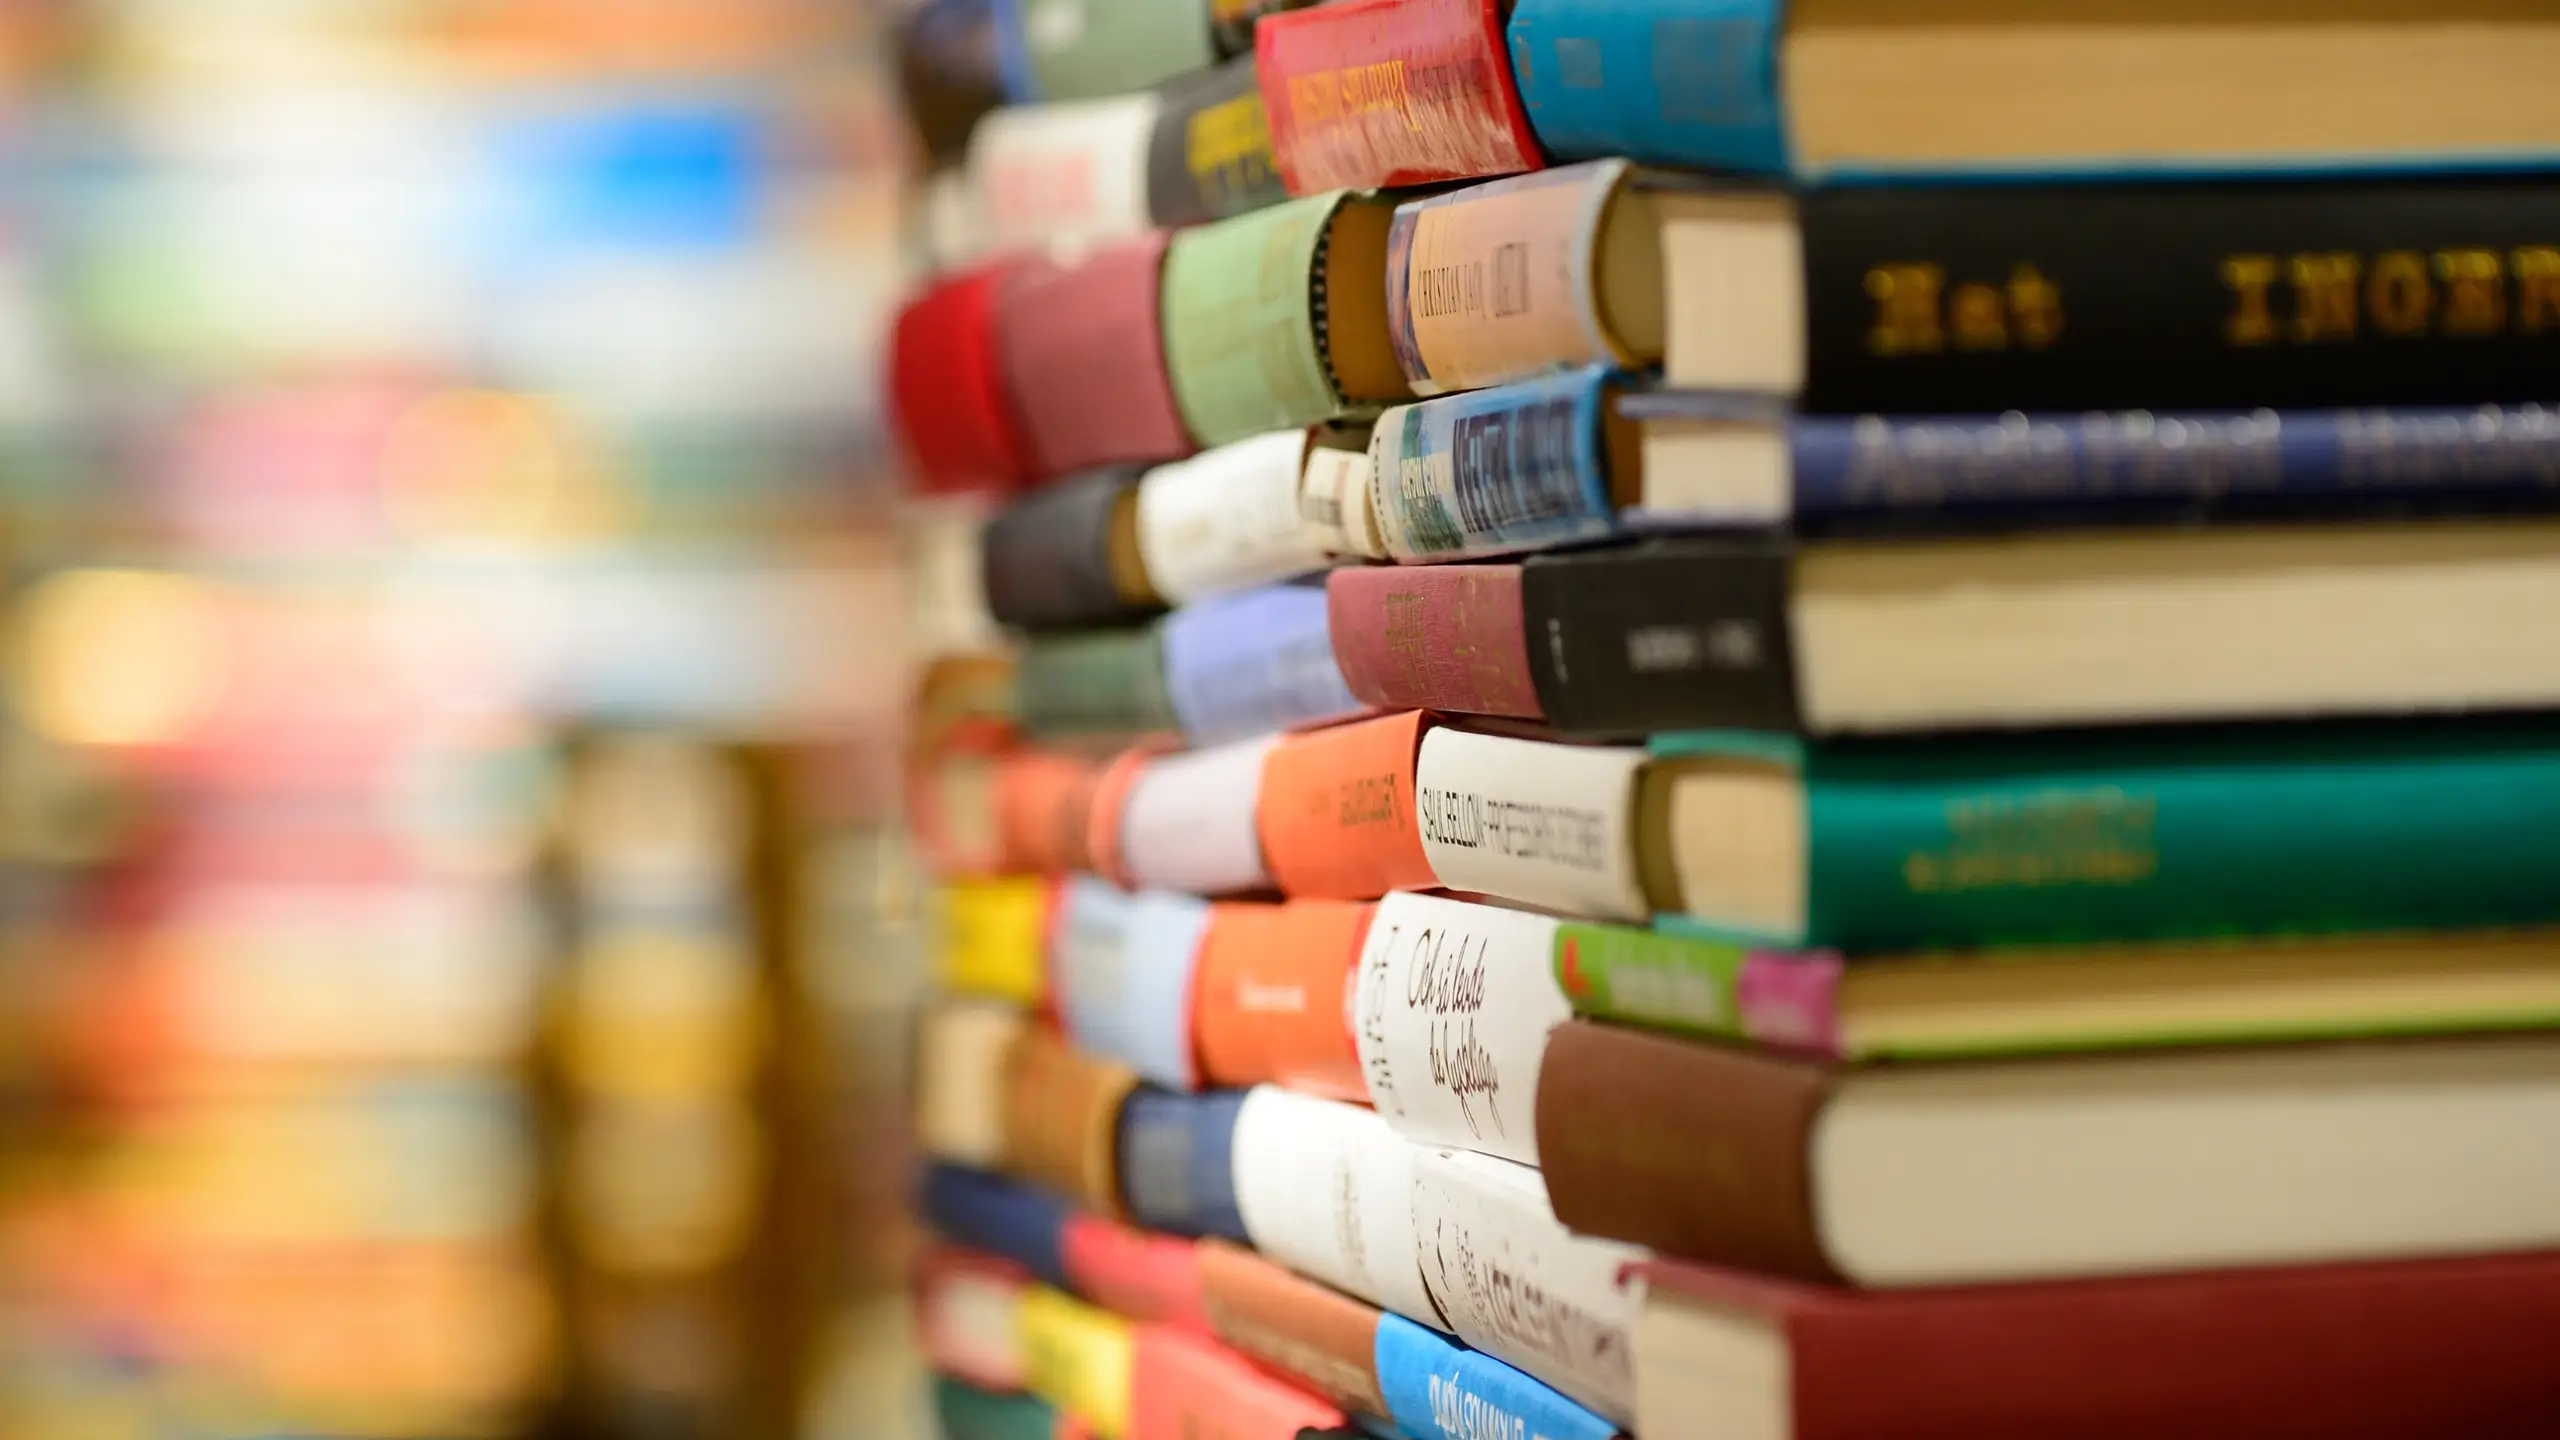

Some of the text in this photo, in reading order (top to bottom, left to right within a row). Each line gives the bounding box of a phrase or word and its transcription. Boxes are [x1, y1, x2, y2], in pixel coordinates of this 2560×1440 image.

[1417, 266, 1461, 318] CHRISTIAN
[1423, 787, 1449, 845] SAUL
[1446, 791, 1487, 849] BELLOW
[1408, 928, 1445, 1014] Och
[1452, 933, 1487, 1015] levde
[1429, 1020, 1445, 1087] de
